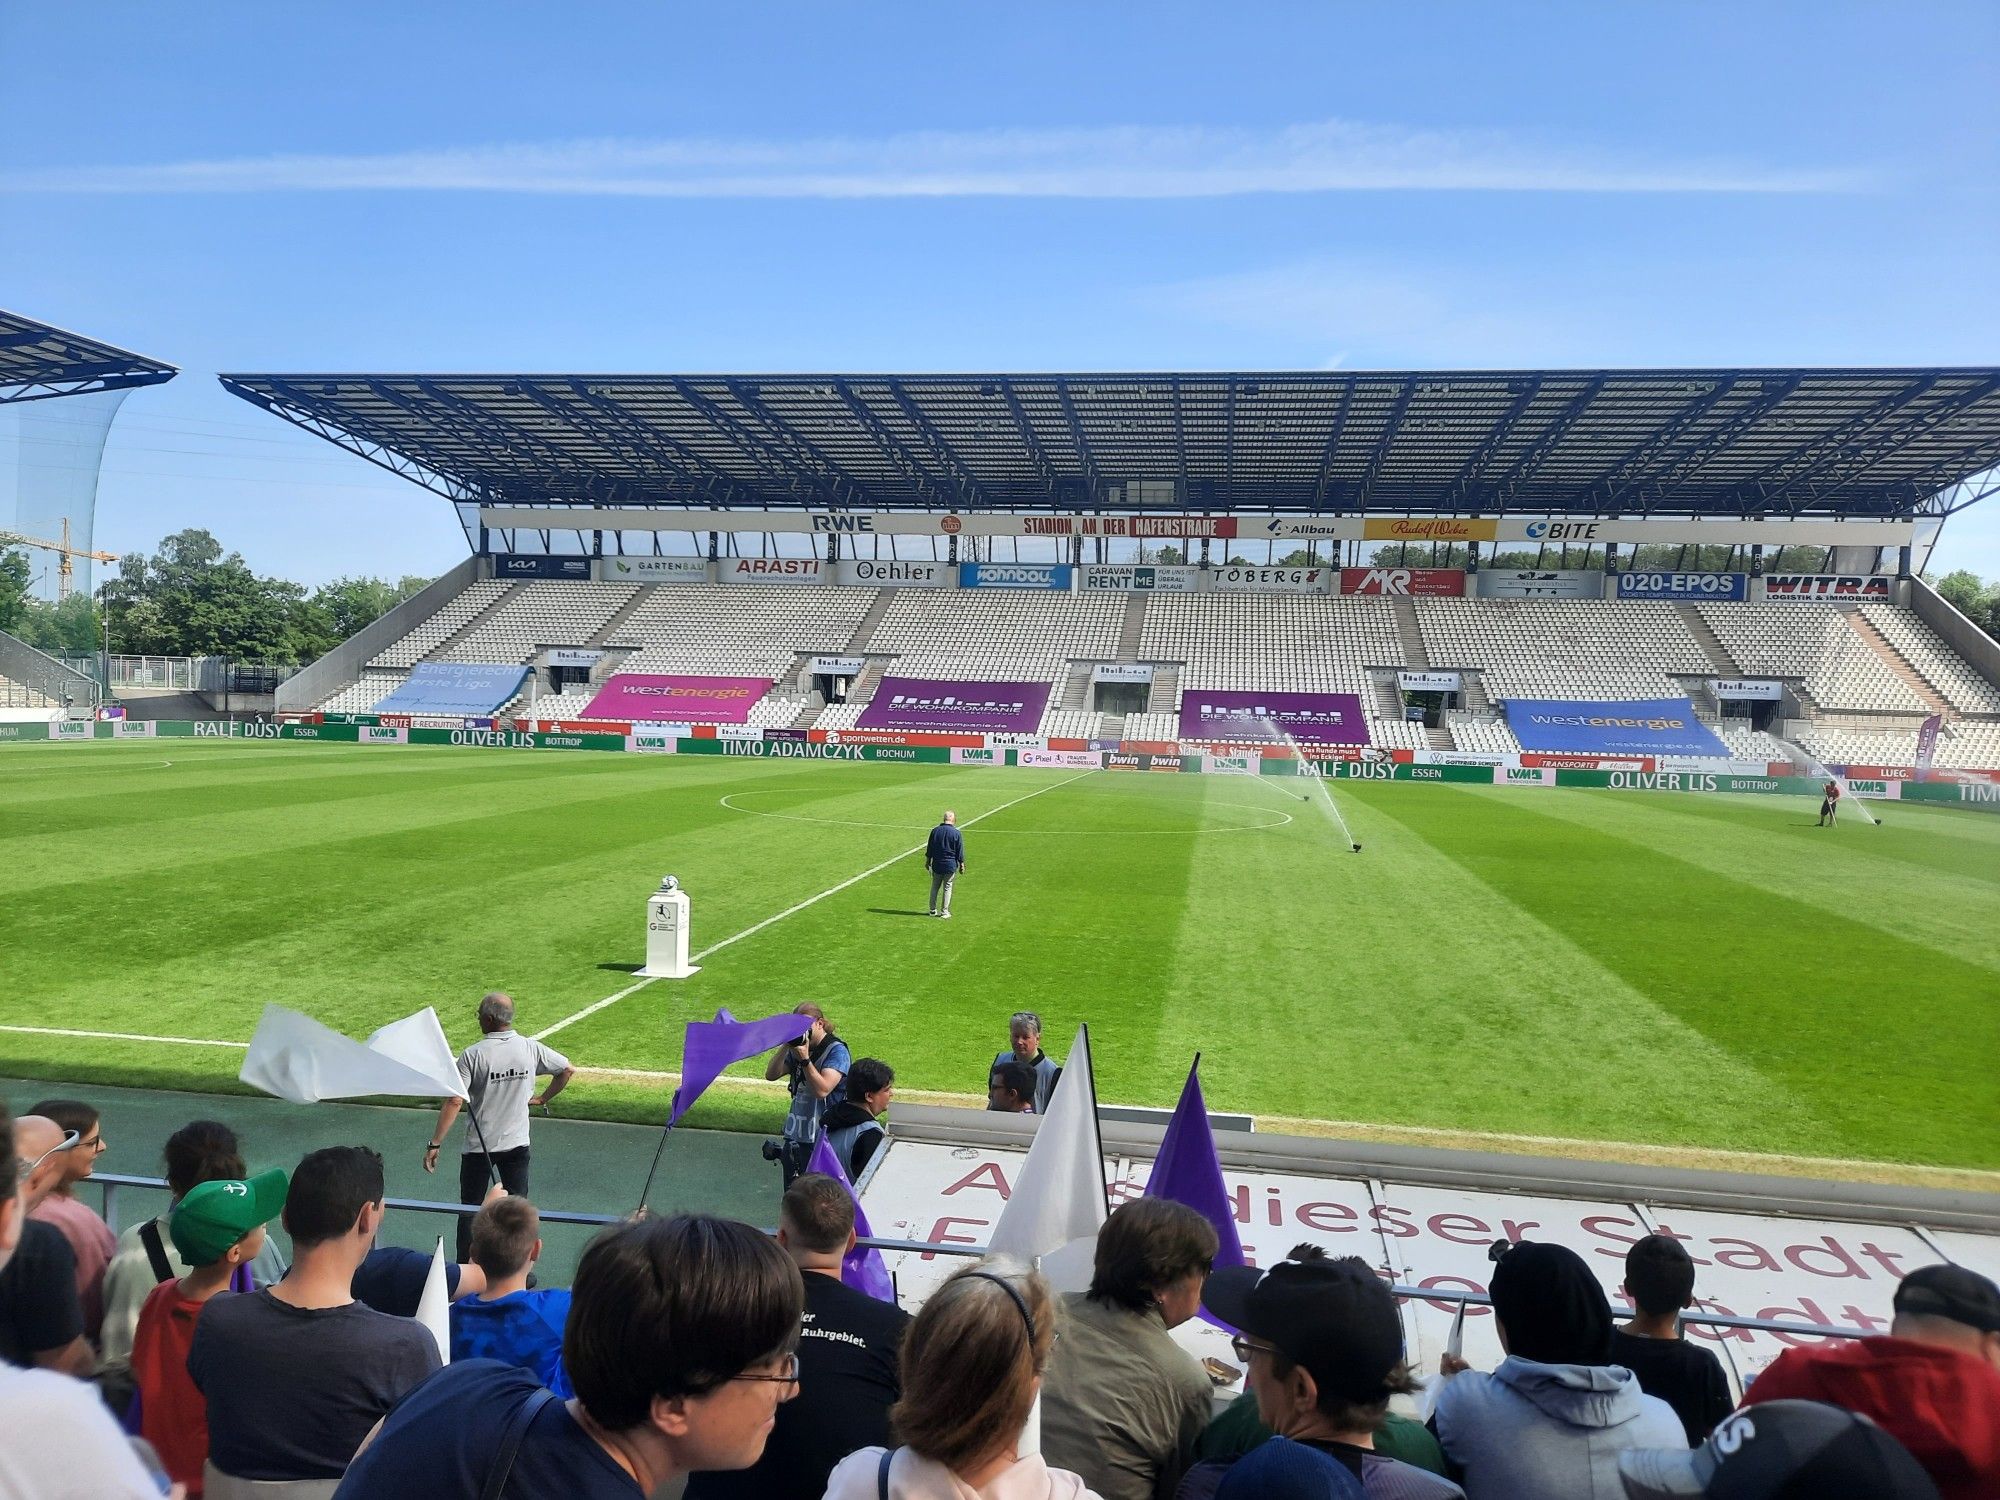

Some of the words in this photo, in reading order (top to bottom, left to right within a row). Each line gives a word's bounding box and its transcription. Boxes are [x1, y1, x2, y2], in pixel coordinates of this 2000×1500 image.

[812, 515, 874, 531] RWE
[1023, 518, 1072, 534] STADION
[1082, 518, 1096, 534] AN
[1104, 518, 1126, 535] DER
[1290, 525, 1335, 535] Allbau
[1391, 521, 1433, 538] Rudolf
[1433, 521, 1468, 535] Weber
[1549, 523, 1600, 539] BITE
[639, 561, 704, 570] GARTENBAU
[736, 560, 819, 574] ARASTI
[856, 561, 934, 579] Oehler
[1088, 567, 1132, 575] CARAVAN
[747, 574, 816, 582] Feuerschutzanlagen
[1088, 575, 1131, 588] RENT
[1135, 577, 1154, 586] ME
[1214, 568, 1302, 583] TÖBERG
[1353, 570, 1411, 595] MKR
[1622, 574, 1733, 592] 020-EPOS
[1767, 577, 1889, 594] WITRA
[419, 662, 521, 676] Energierecht,
[411, 678, 451, 688] erste
[455, 679, 493, 689] Liga.
[622, 684, 750, 699] westenergie
[913, 704, 1021, 713] WOHNKOMPANIE
[389, 718, 410, 728] BITE
[413, 721, 464, 729] E-RECRUITING
[1531, 714, 1684, 730] westenergie
[194, 722, 238, 737] RALF
[245, 723, 284, 738] DUSY
[294, 728, 318, 736] ESSEN
[369, 728, 389, 737] LVM
[451, 731, 506, 746] OLIVER
[512, 733, 535, 747] LIS
[545, 737, 582, 745] BOTTROP
[842, 735, 906, 744] sportwetten.de
[1604, 741, 1702, 749] westenergie.de
[721, 740, 763, 755] TIMO
[770, 742, 864, 759] ADAMCZYK
[876, 749, 915, 758] BOCHUM
[962, 749, 983, 759] LVM
[1035, 754, 1052, 763] Pixel
[1109, 754, 1139, 765] bwin
[1150, 756, 1181, 766] bwin
[1541, 760, 1596, 769] TRANSPORTE
[1297, 760, 1342, 777] RALF
[1350, 762, 1399, 779] DUSY
[1411, 768, 1442, 778] ESSEN
[1507, 769, 1532, 779] LVM
[1881, 769, 1909, 778] LUEG.
[1610, 772, 1681, 790] OLIVER
[1688, 774, 1717, 791] LIS
[1731, 780, 1778, 790] BOTTROP
[1849, 781, 1874, 792] LVM
[1958, 784, 2000, 801] TIM
[1580, 1216, 1905, 1281] Stadt
[801, 1328, 867, 1348] Ruhrgebiet.
